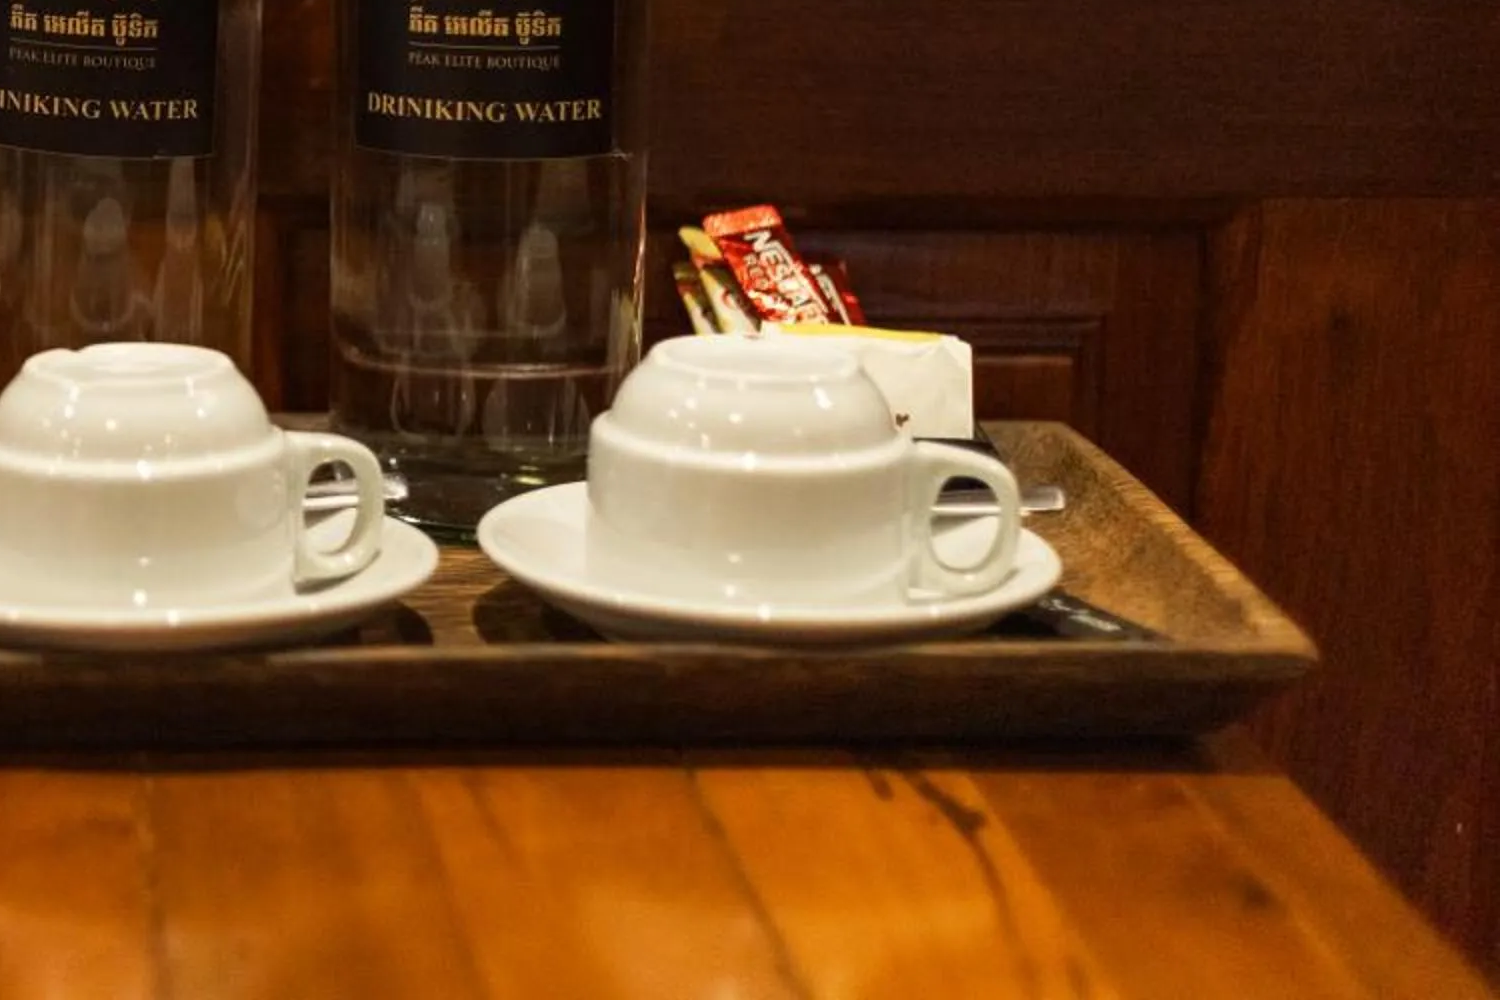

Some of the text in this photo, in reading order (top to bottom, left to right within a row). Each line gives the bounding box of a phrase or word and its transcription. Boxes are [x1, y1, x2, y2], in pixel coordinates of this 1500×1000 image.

[83, 54, 157, 71] BOUTIQUE
[408, 51, 561, 72] PEAK ELITE BOUTIQUE
[109, 99, 198, 120] WATER
[367, 91, 602, 122] DRINIKING WATER
